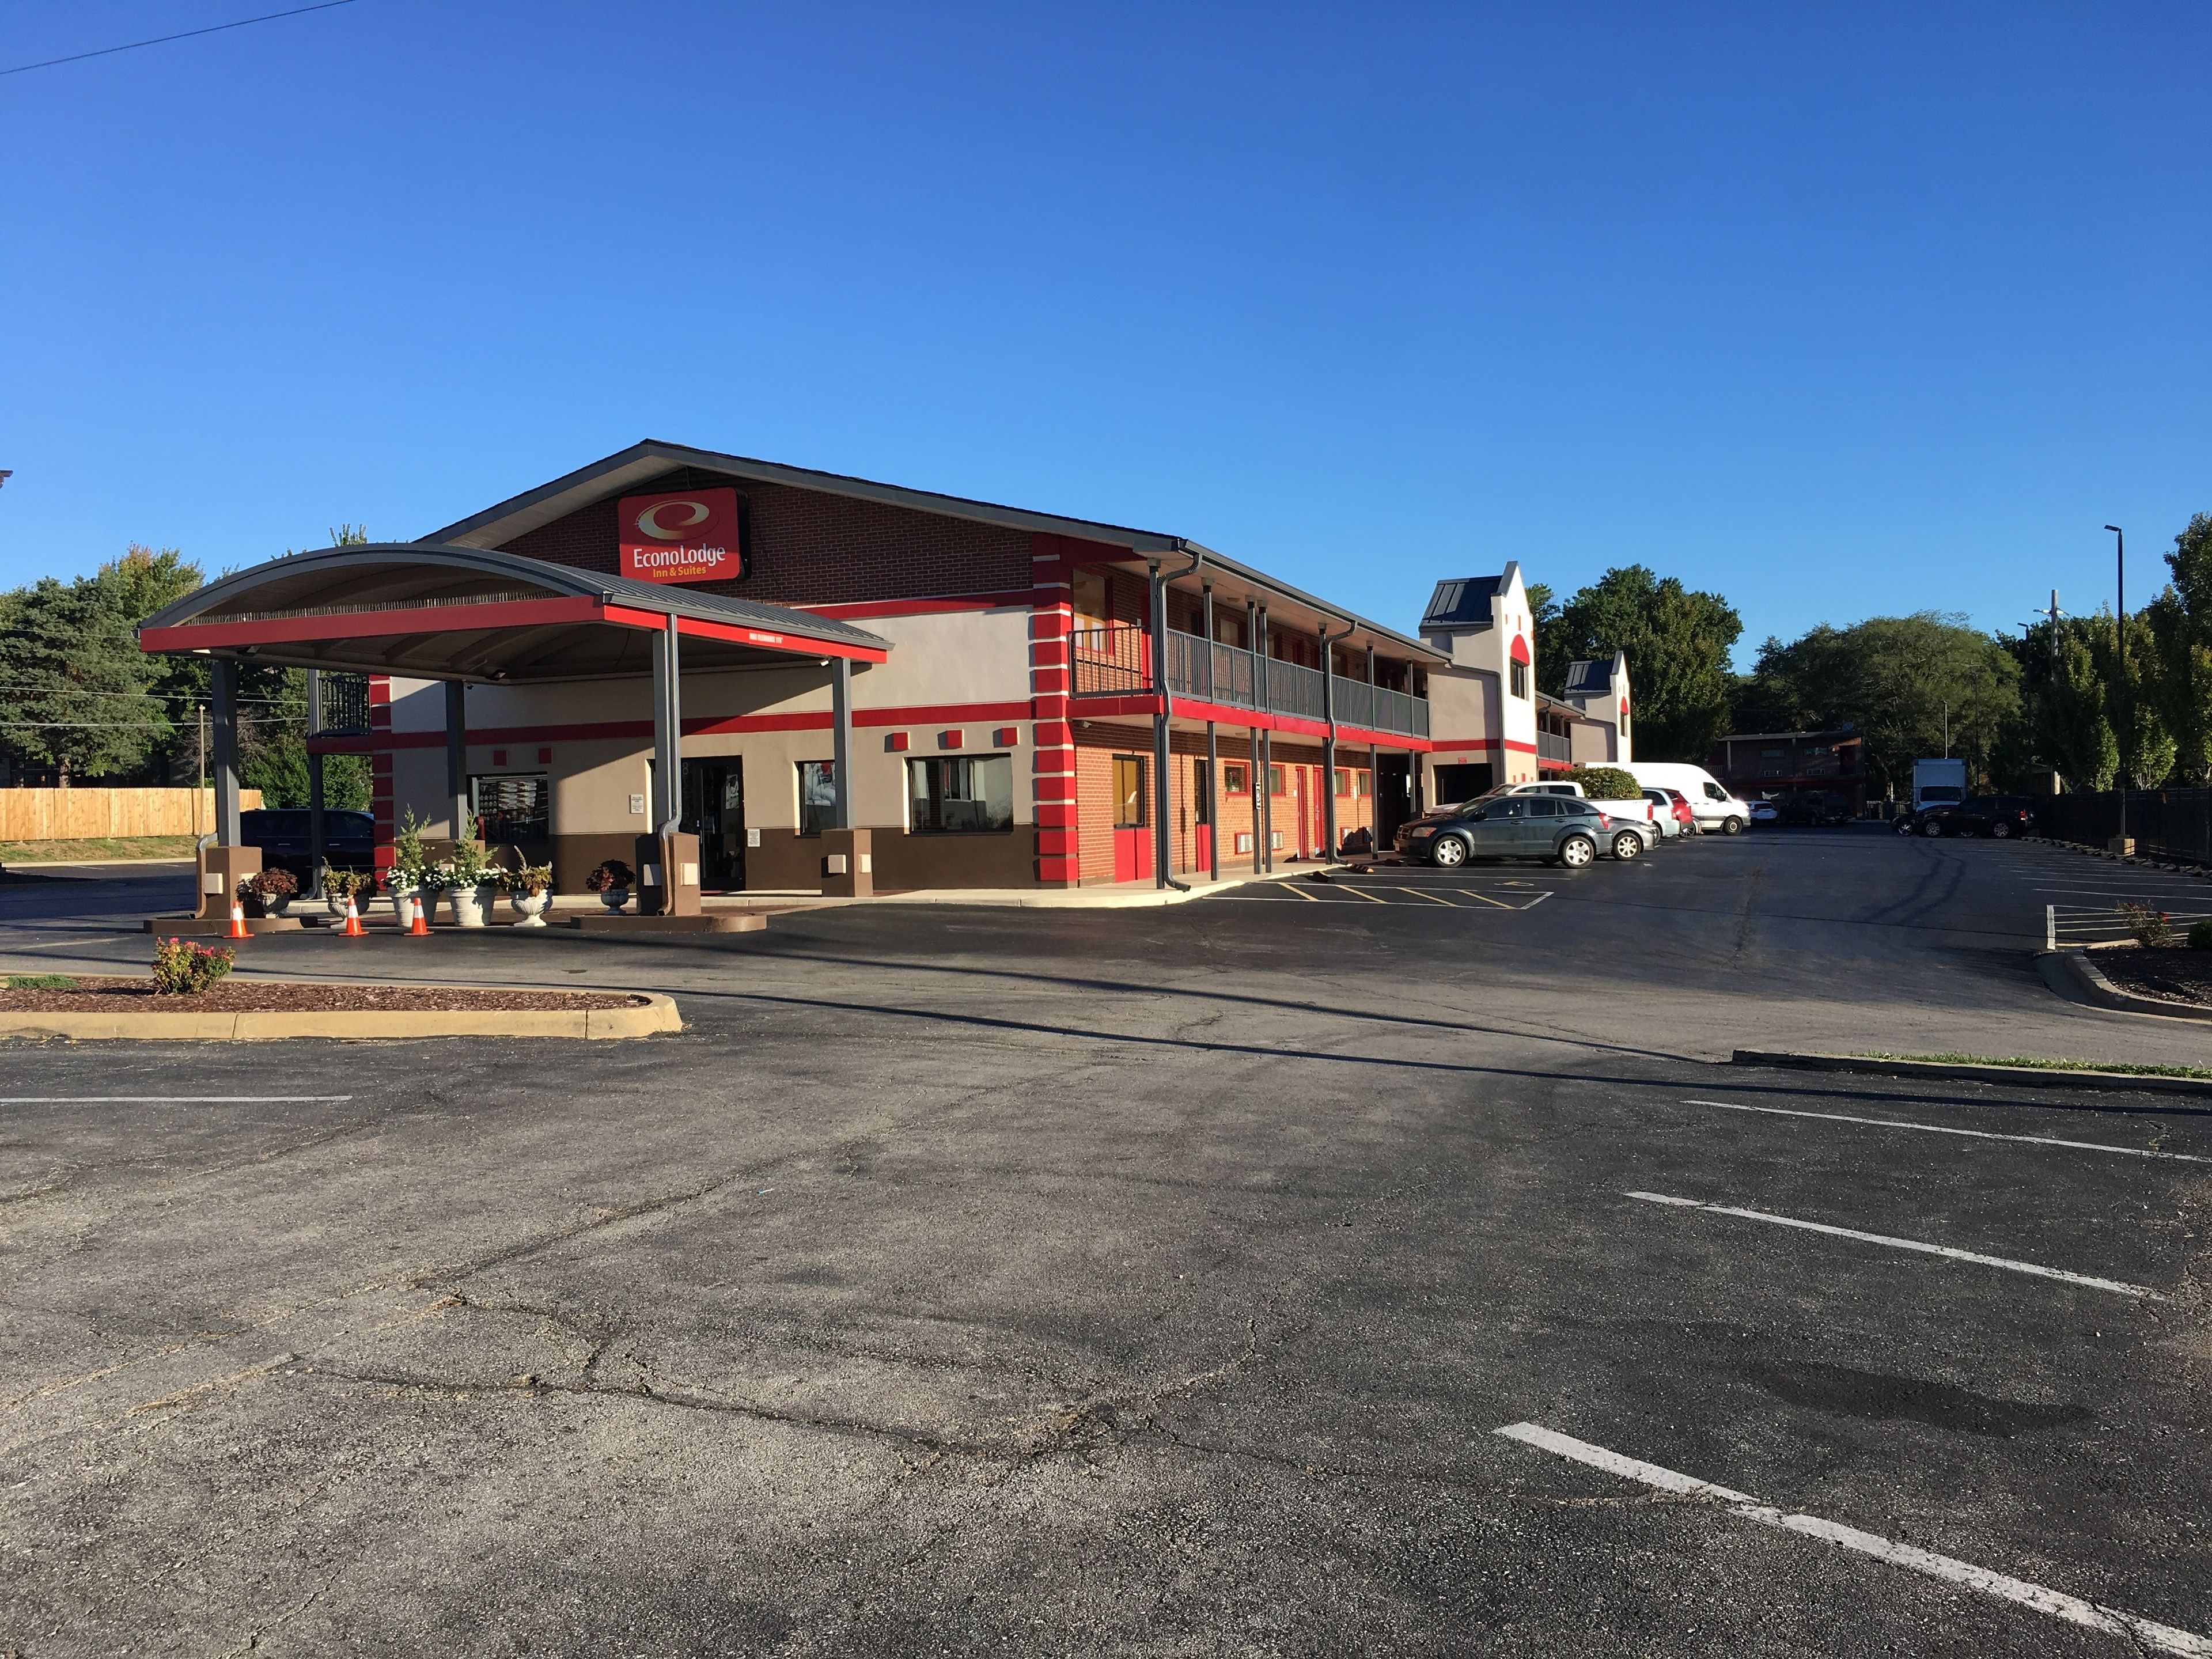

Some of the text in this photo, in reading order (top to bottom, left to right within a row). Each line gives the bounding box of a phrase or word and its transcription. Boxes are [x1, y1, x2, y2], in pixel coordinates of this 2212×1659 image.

[634, 543, 726, 568] EconoLodge
[653, 566, 706, 578] Inn & Suites
